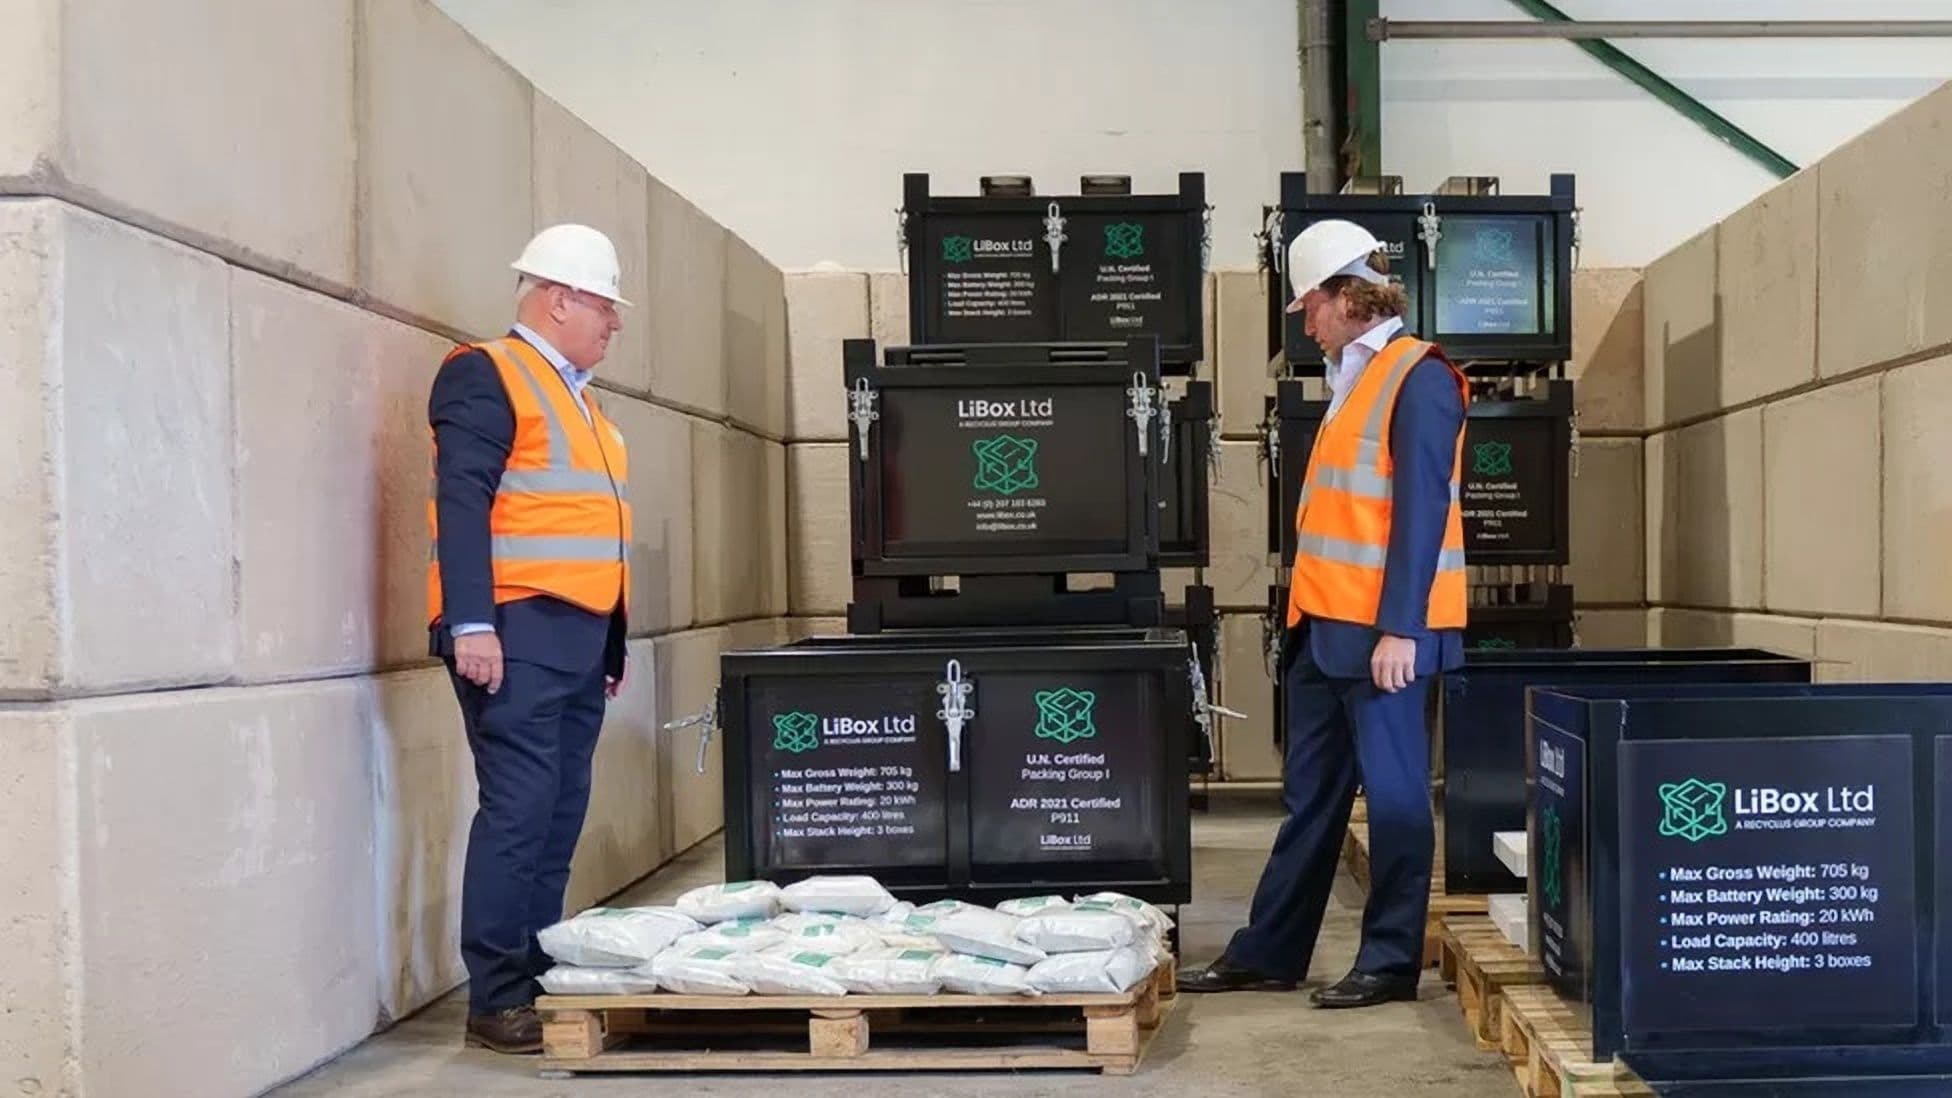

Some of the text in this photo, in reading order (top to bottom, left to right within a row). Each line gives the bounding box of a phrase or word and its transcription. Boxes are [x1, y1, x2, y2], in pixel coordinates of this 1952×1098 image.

[973, 239, 1032, 252] LiBox Ltd
[958, 398, 1053, 417] LiBox Ltd
[823, 714, 915, 735] LiBox Ltd
[1026, 753, 1105, 765] U.N. Certified
[781, 766, 912, 778] Max Gross Weight: 705 kg
[1021, 768, 1066, 782] Packing
[1068, 768, 1104, 782] Group
[782, 781, 919, 793] Max Battery Weight: 300 kg
[782, 799, 804, 807] Max
[806, 798, 838, 807] Power
[840, 797, 876, 807] Rating:
[880, 796, 892, 805] 20
[1010, 798, 1121, 809] ADR 2021 Certified
[1734, 785, 1874, 814] LiBox Ltd
[783, 813, 809, 822] Load
[811, 812, 859, 823] Capacity:
[862, 811, 880, 820] 400
[1050, 812, 1079, 823] P911
[1735, 818, 1876, 829] A RECYCLUS GROUP COMPANY
[783, 824, 914, 837] Max Stack Height: 3 boxes
[1041, 834, 1091, 845] LiBox Ltd
[1670, 863, 1870, 881] Max Gross Weight: 705 kg
[1671, 885, 1878, 905] Max Battery Weight: 300 kg
[1671, 908, 1874, 926] Max Power Rating: 20 kWh
[1672, 931, 1857, 949] Load Capacity: 400 litres
[1672, 953, 1872, 972] Max Stack Height: 3 boxes
